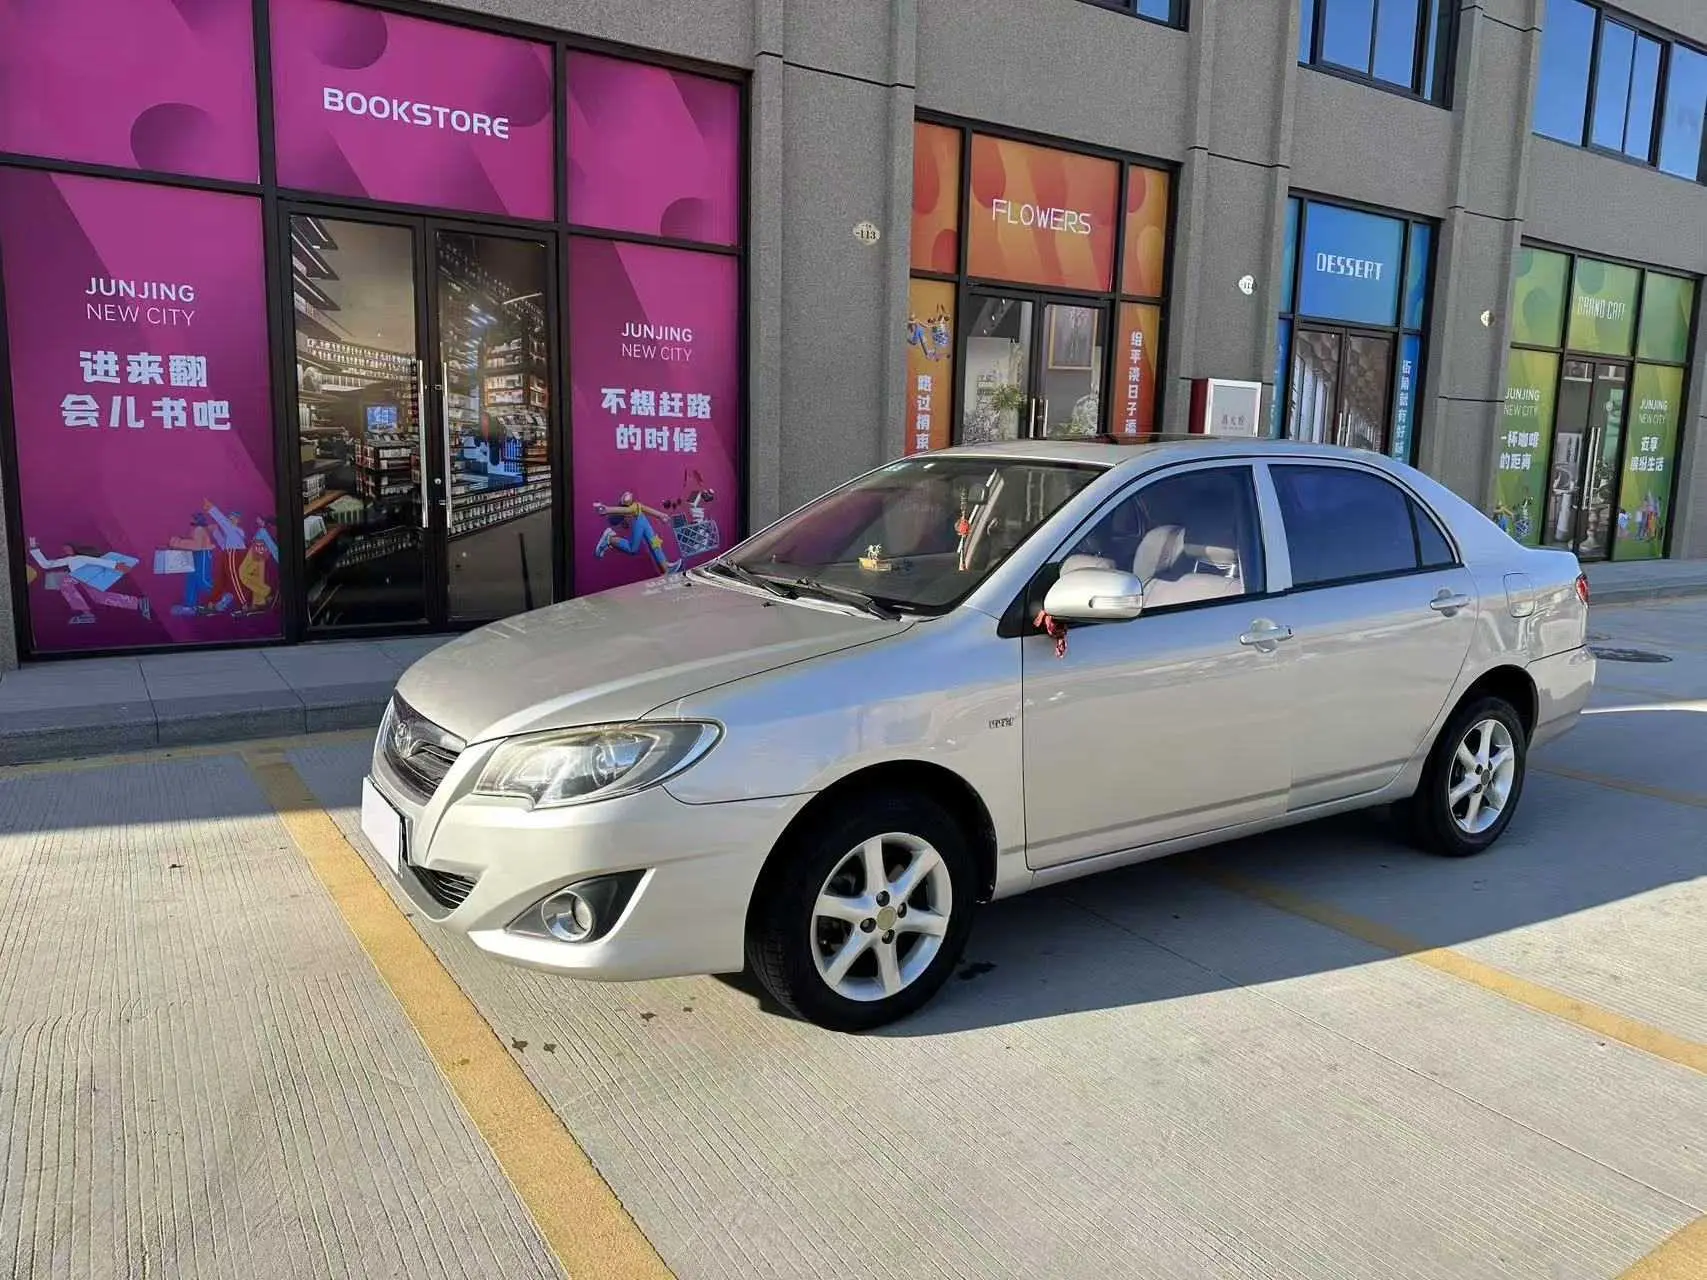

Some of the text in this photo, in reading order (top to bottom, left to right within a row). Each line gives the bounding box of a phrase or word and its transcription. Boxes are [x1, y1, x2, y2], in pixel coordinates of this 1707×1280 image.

[323, 87, 509, 140] BOOKSTORE
[992, 198, 1092, 235] FLOWERS
[1316, 252, 1384, 281] DESSERT
[86, 277, 195, 303] JUNJING
[86, 303, 196, 327] NEW CITY
[621, 322, 693, 343] JUNJING
[621, 343, 693, 362] NEW CITY
[79, 349, 208, 388] 进来翻
[600, 387, 713, 420] 不想赶路
[1505, 387, 1540, 401] JUNJING
[59, 393, 232, 431] 会儿书吧
[1503, 403, 1521, 416] NEW
[615, 424, 699, 453] 的时候
[1500, 431, 1540, 448] 一杯咖啡
[1499, 452, 1532, 470] 的距离
